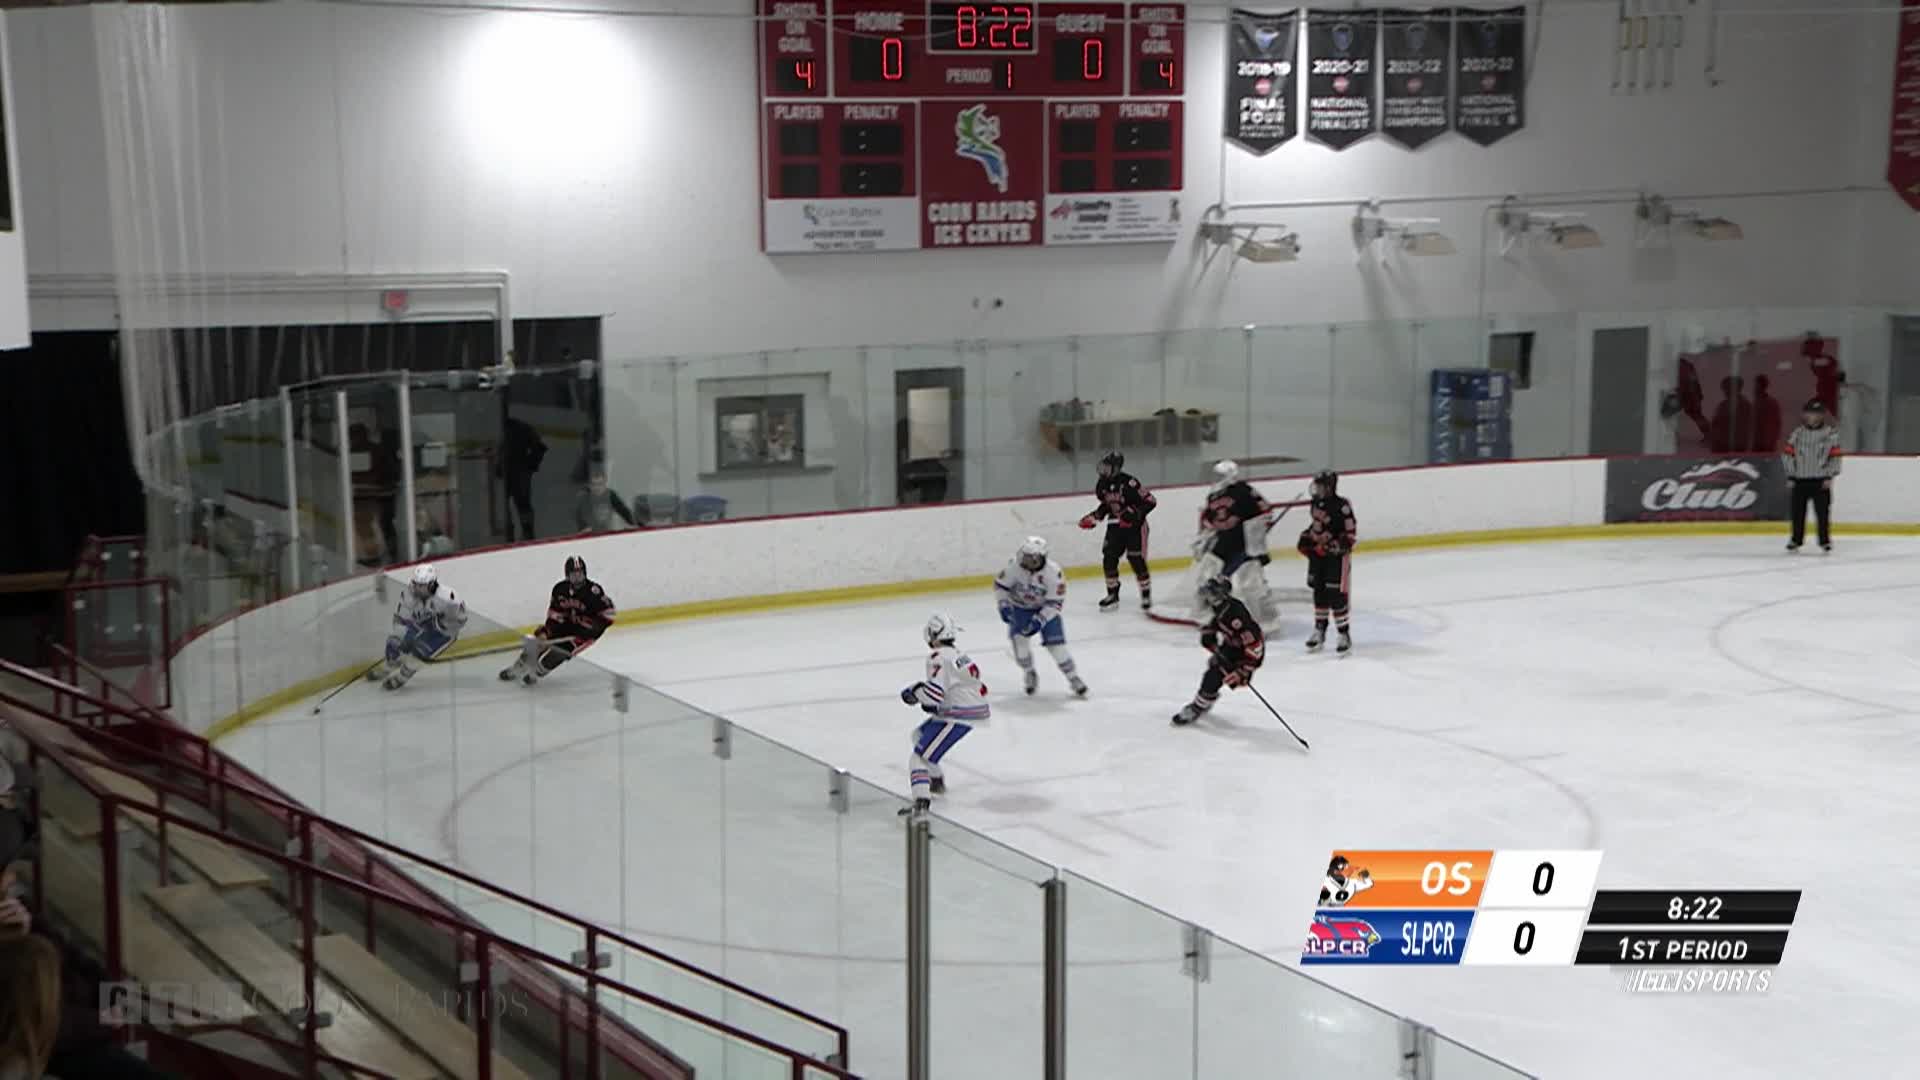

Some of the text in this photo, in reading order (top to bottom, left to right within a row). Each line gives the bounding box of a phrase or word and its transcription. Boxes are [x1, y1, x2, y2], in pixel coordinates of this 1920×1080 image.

[786, 20, 806, 34] ON
[854, 11, 904, 31] HOME
[957, 6, 1031, 48] 8:22
[1056, 13, 1106, 32] GUEST
[778, 37, 814, 52] GOAL
[1141, 39, 1174, 53] GOAL
[883, 38, 902, 80] 0
[1084, 39, 1102, 79] 0
[796, 61, 812, 89] 4
[946, 68, 992, 83] PERIOD
[1007, 61, 1013, 88] 1
[1159, 61, 1173, 88] 4
[774, 105, 898, 120] PLAYER PENALTY
[1056, 104, 1170, 118] PLAYER PENALTY
[1240, 97, 1285, 110] FINAL
[1240, 111, 1285, 123] FOUR
[976, 200, 1036, 221] RAPIDS
[935, 223, 1031, 244] ICE CENTER
[1641, 478, 1758, 512] Club
